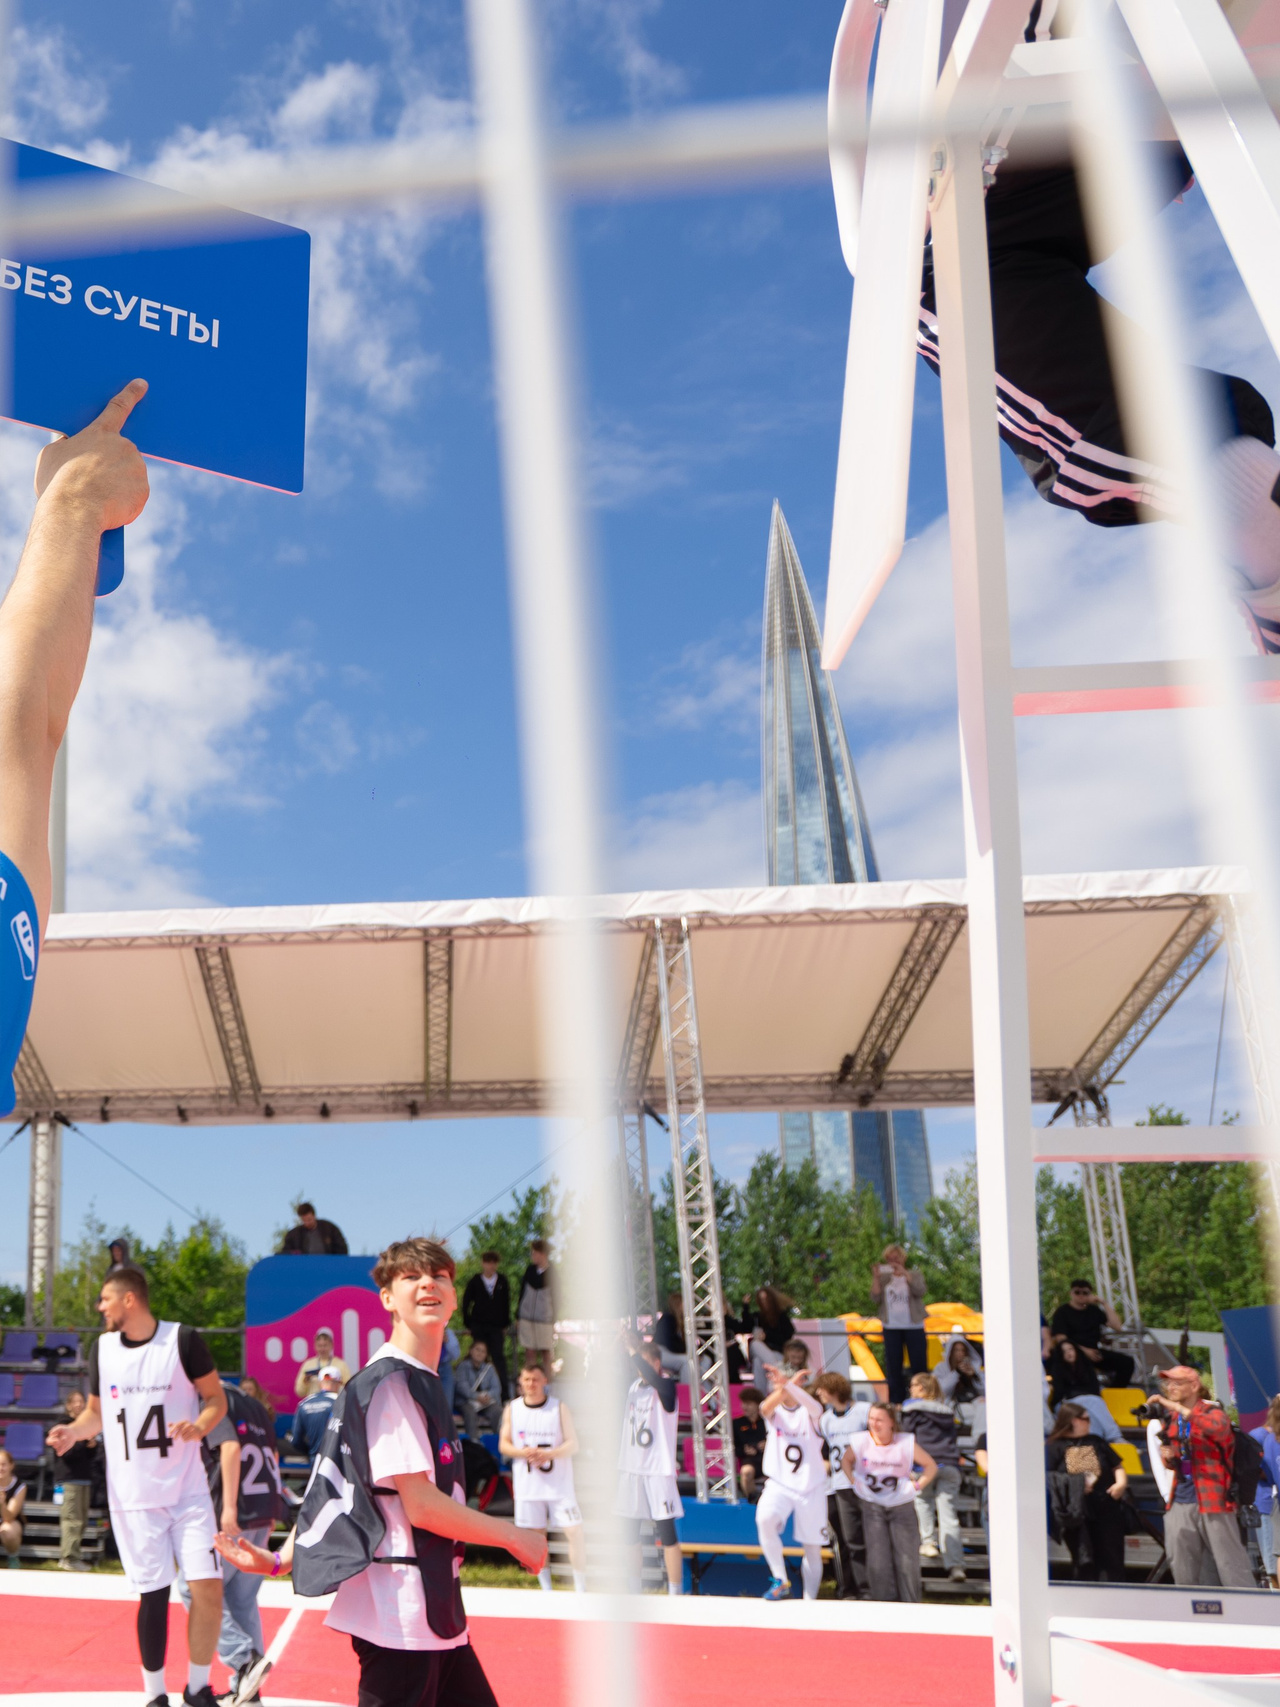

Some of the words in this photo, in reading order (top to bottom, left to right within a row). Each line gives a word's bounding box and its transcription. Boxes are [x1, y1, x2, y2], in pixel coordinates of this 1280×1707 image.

[84, 284, 220, 348] СУЕТЫ
[116, 1404, 174, 1461] 14
[629, 1415, 653, 1448] 16
[785, 1444, 803, 1474] 9
